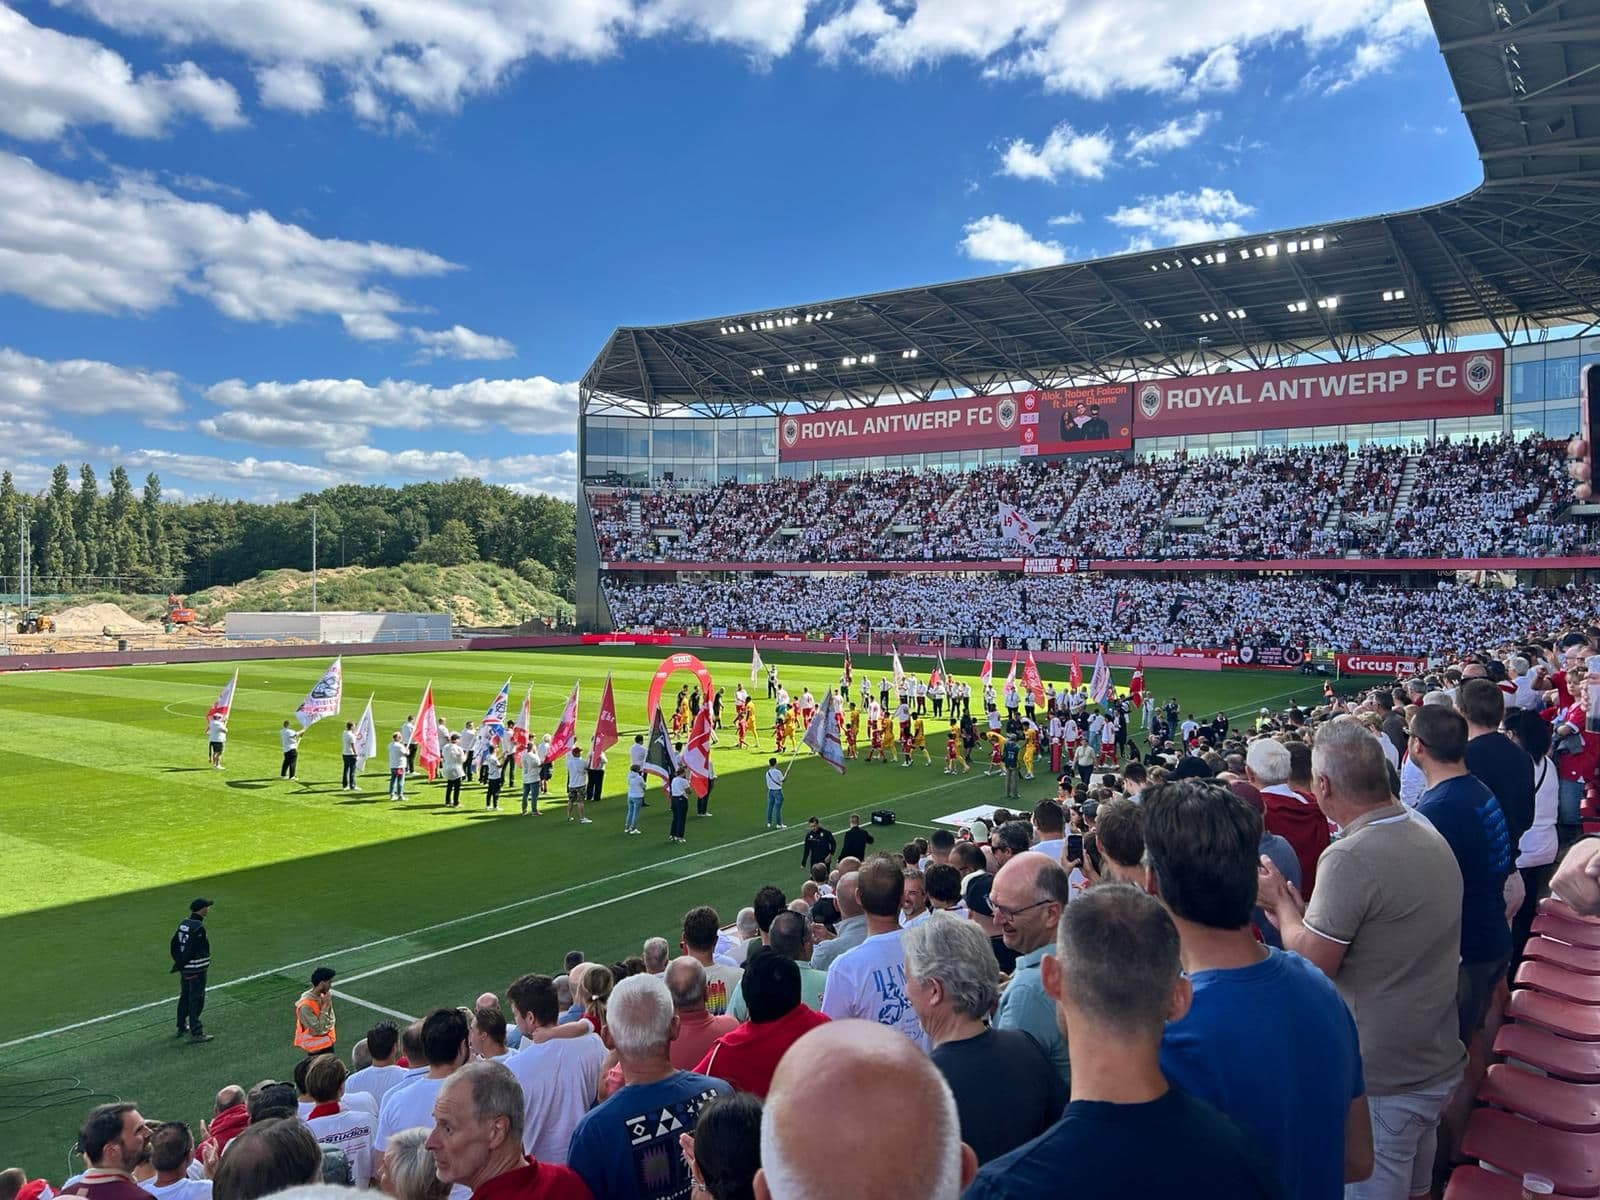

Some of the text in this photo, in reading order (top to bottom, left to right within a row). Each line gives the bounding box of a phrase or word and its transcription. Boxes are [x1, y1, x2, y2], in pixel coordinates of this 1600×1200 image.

[1064, 388, 1094, 399] Robert
[1097, 385, 1127, 396] Falcon
[1167, 366, 1457, 410] ROYAL ANTWERP FC
[801, 406, 993, 440] ROYAL ANTWERP FC
[1347, 657, 1393, 671] Circus
